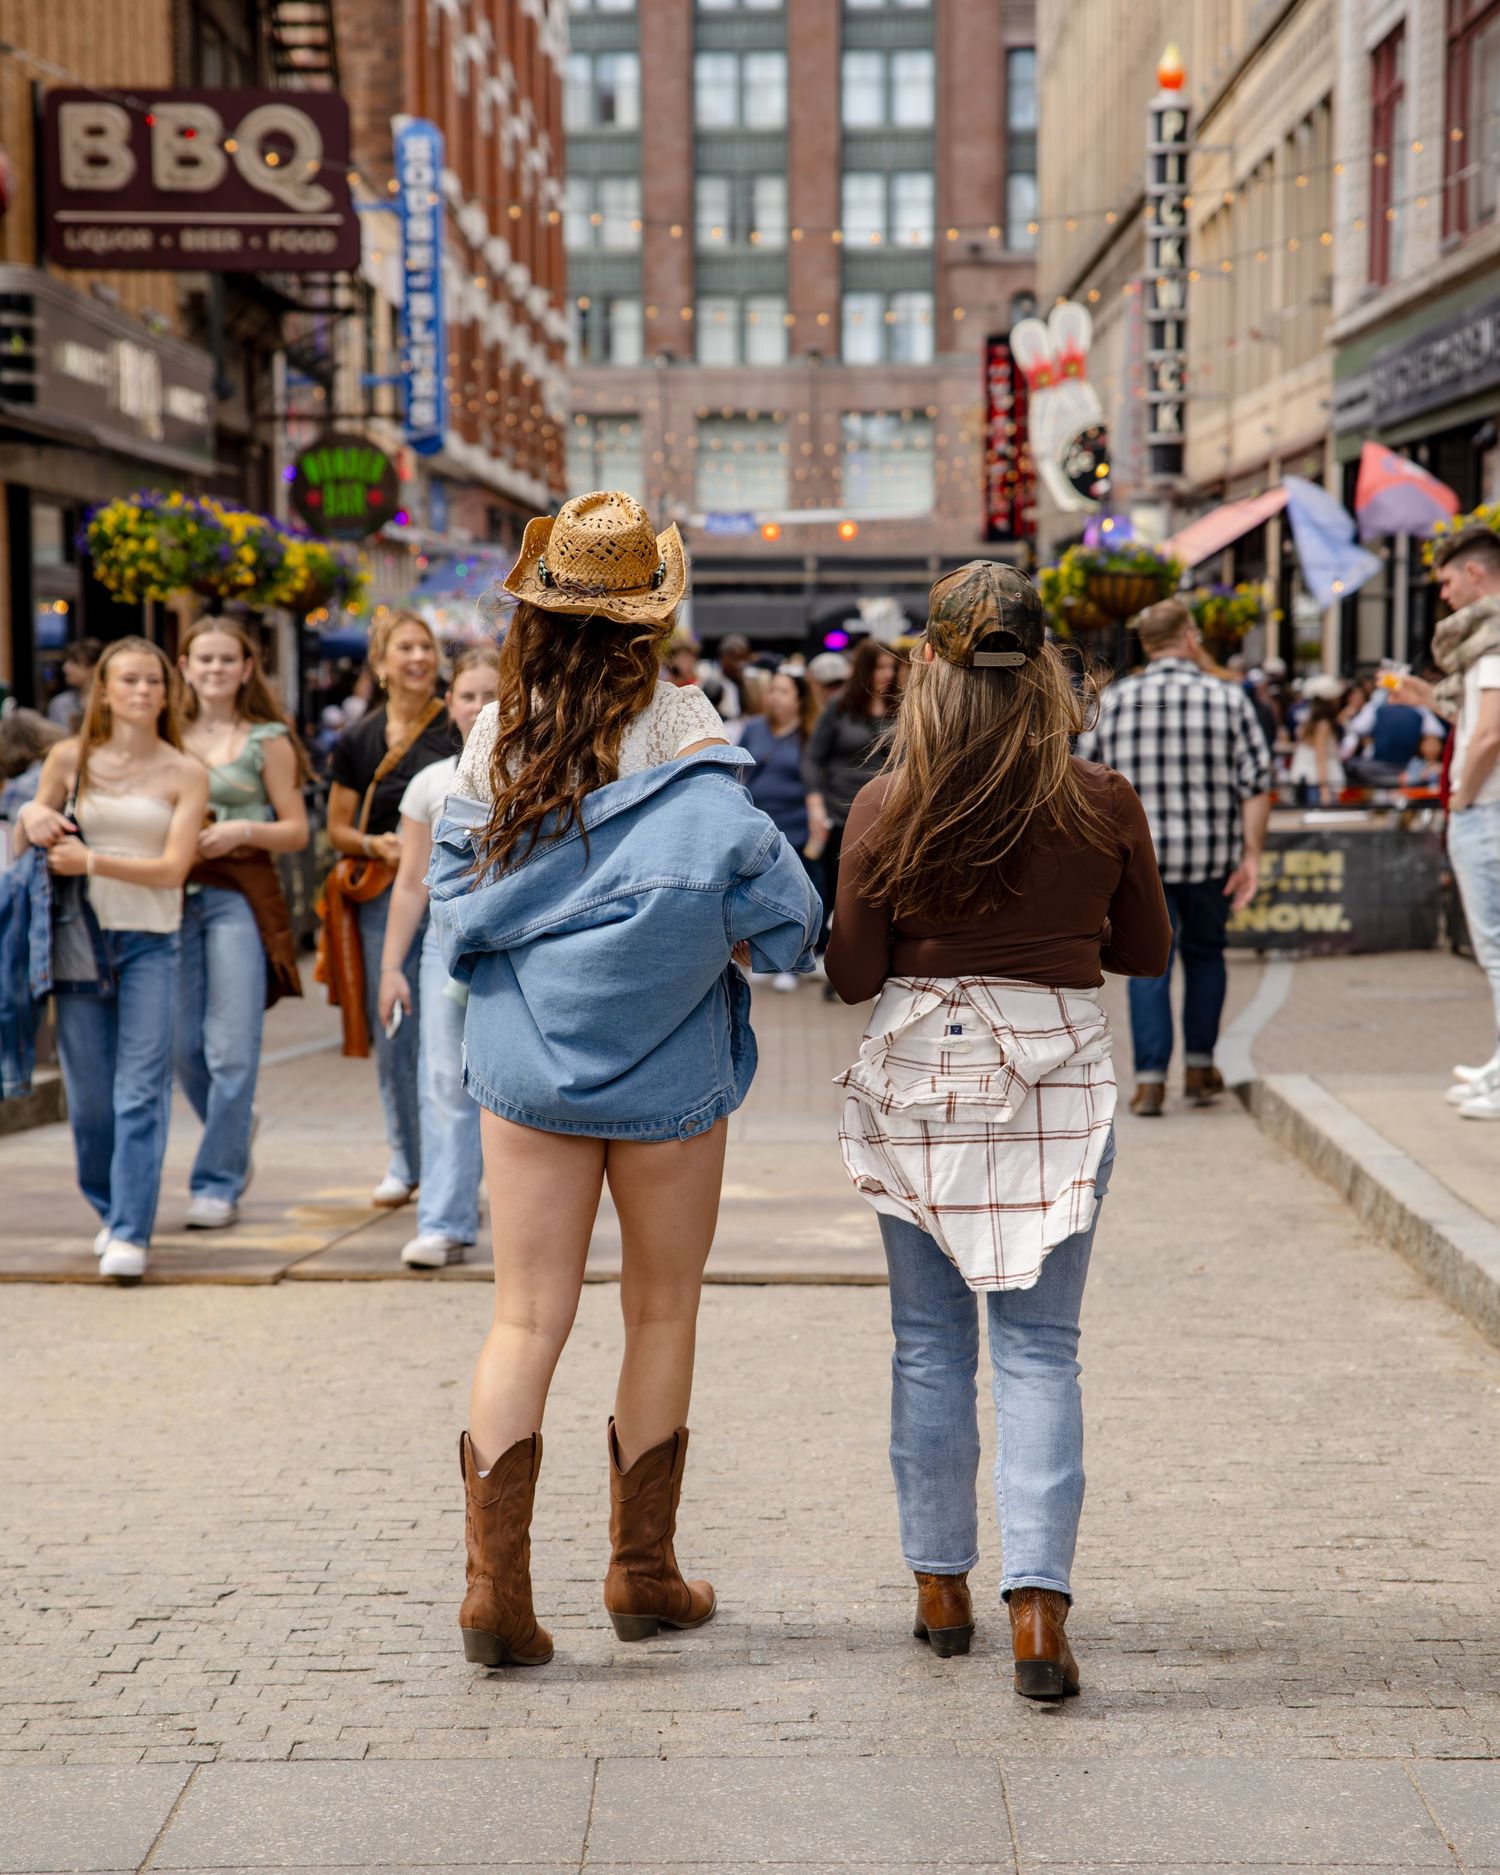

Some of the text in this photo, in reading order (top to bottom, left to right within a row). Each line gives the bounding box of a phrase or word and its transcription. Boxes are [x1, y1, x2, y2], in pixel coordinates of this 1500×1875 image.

[58, 102, 333, 213] BBQ
[63, 227, 338, 254] LIQUOR BEER FOOD
[1158, 111, 1185, 432] PICKWICK
